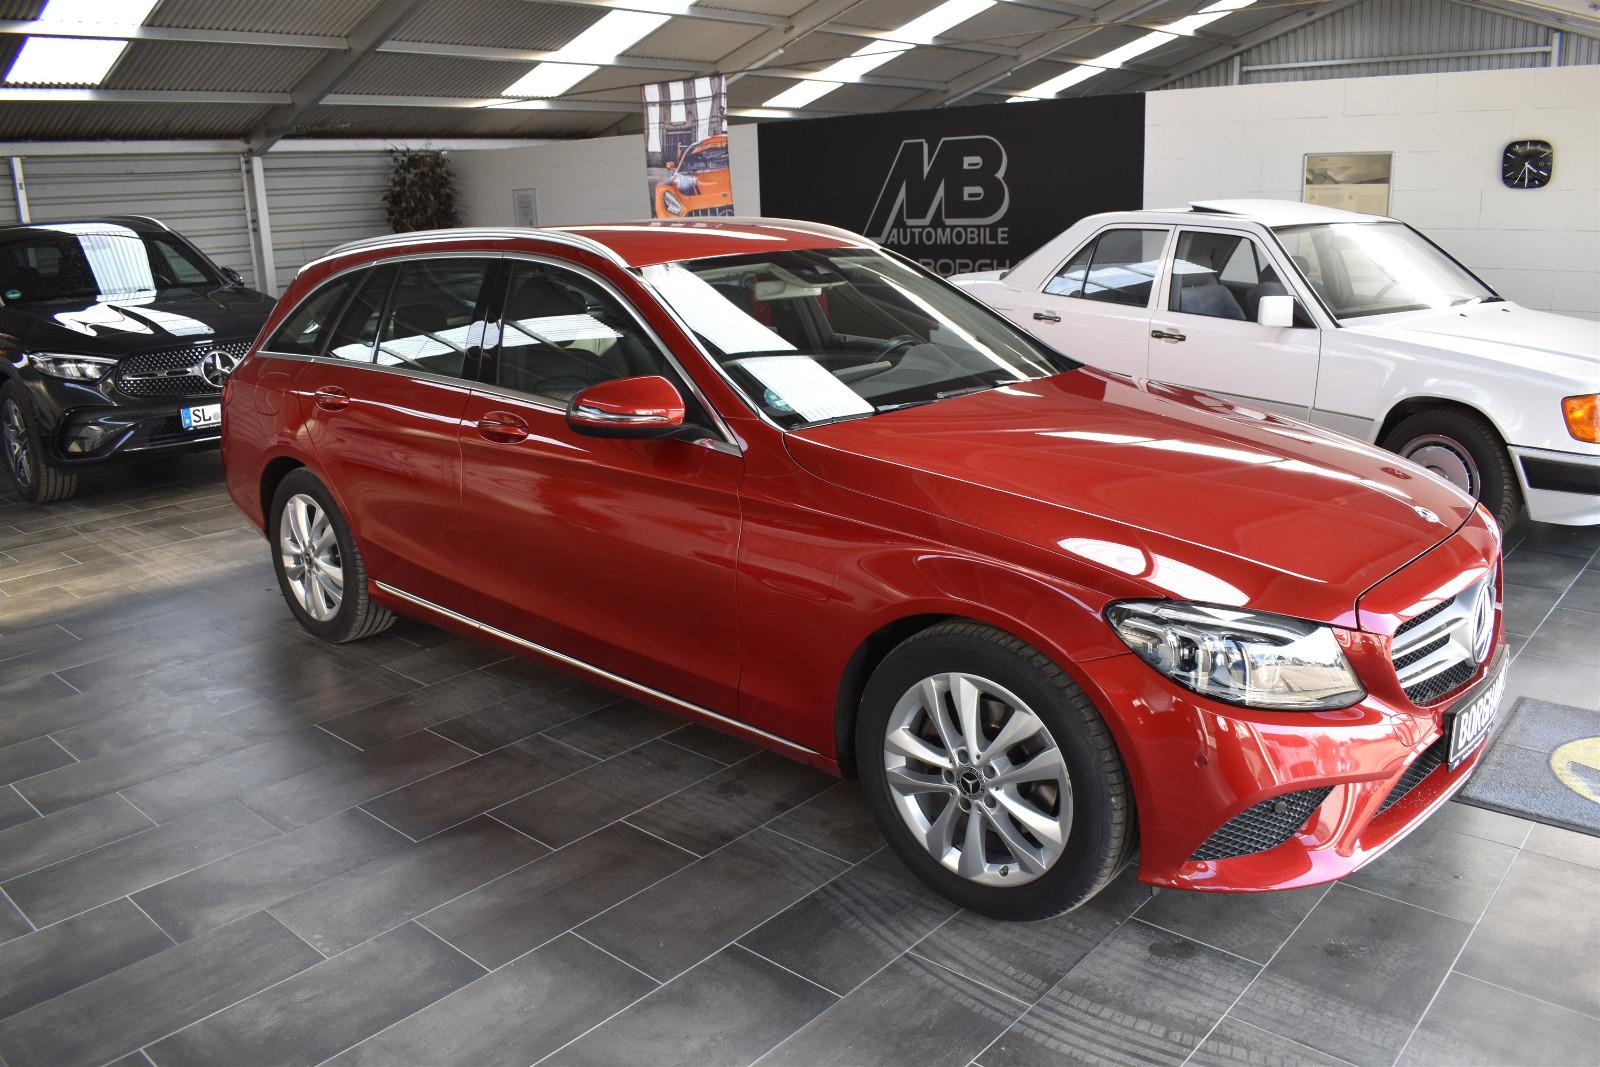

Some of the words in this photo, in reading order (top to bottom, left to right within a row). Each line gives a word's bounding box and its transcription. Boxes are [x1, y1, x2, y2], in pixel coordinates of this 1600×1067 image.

[863, 135, 1010, 242] MB
[887, 227, 1009, 245] AUTOMOBILE
[192, 408, 212, 423] SL
